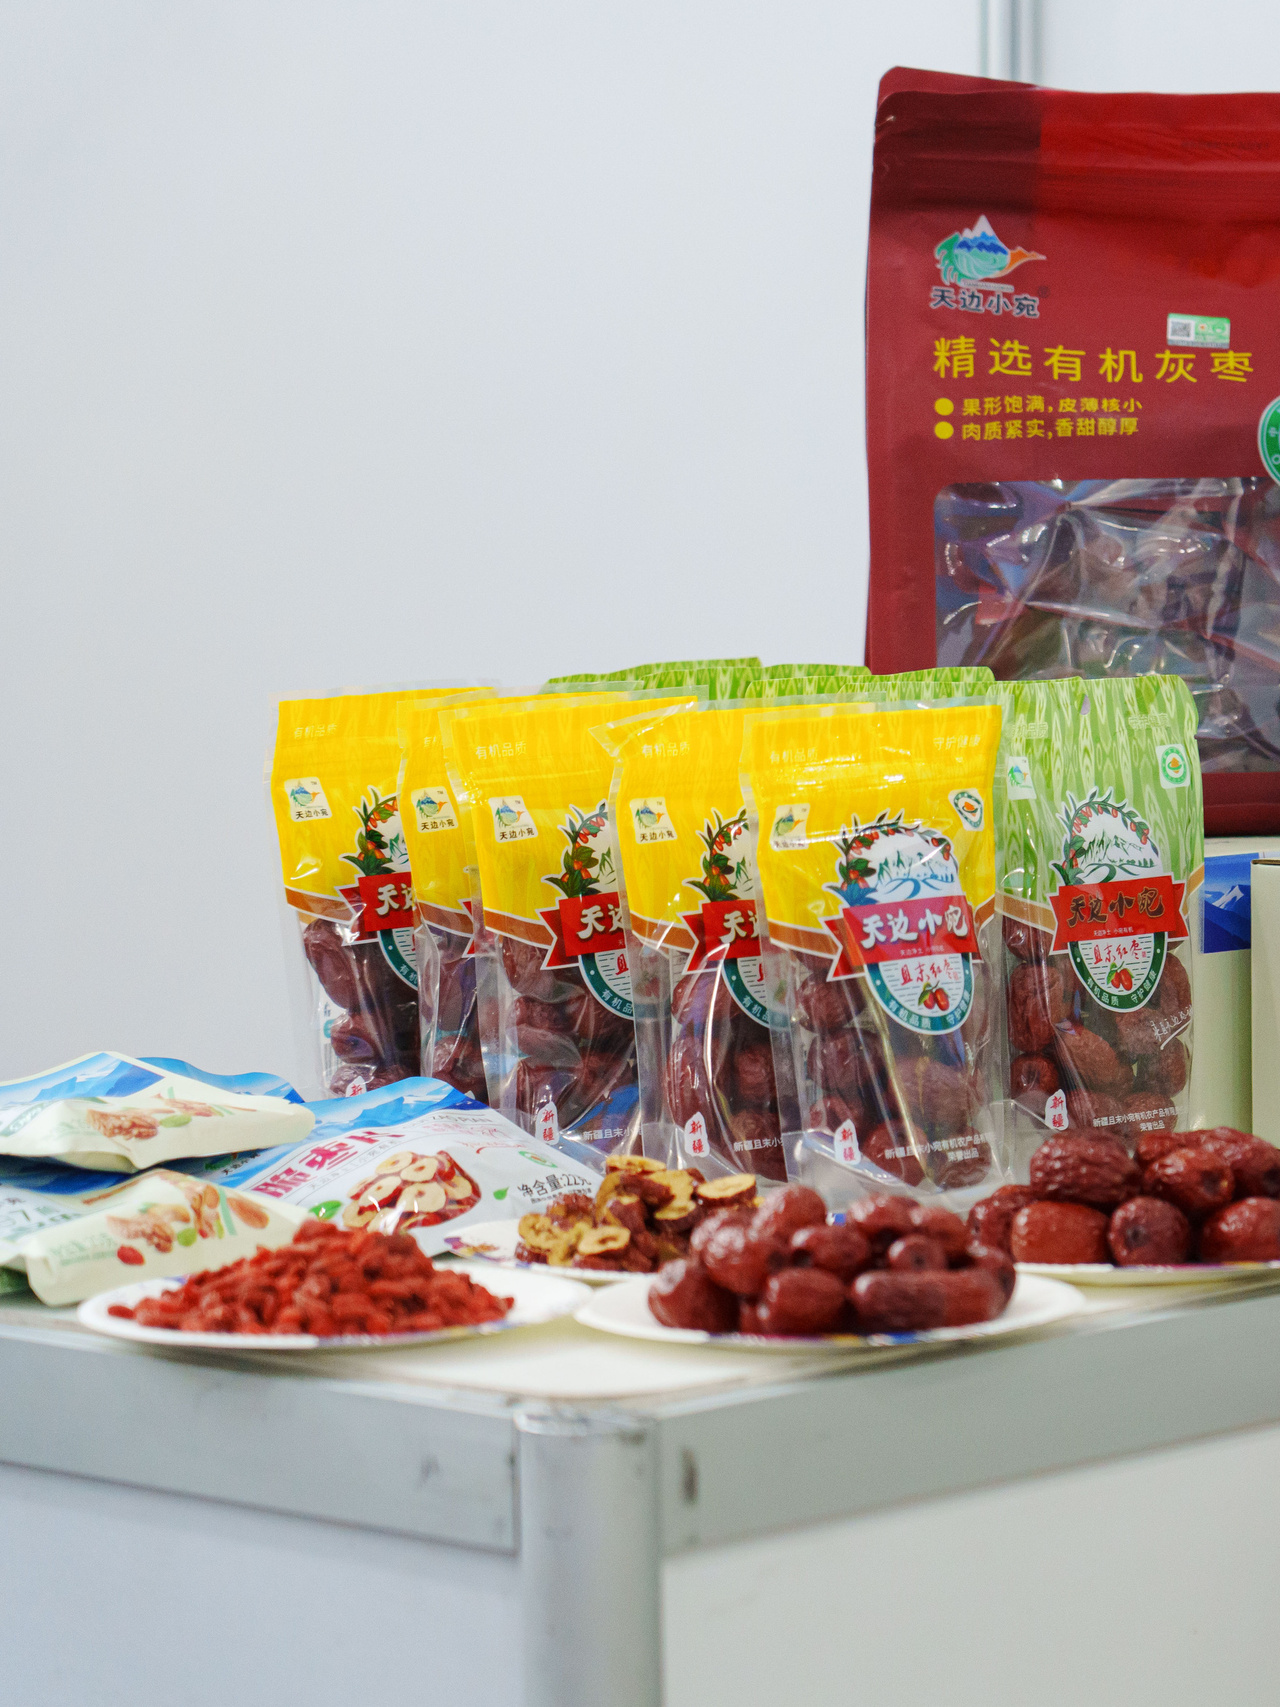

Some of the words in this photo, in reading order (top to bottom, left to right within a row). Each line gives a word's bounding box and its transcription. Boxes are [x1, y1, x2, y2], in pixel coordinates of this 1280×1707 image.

[930, 287, 1040, 318] 天边小宛
[933, 335, 1254, 384] 精选有机灰枣
[475, 741, 527, 760] 有机品质
[642, 741, 690, 759] 有机品质
[421, 819, 455, 831] 天边小宛
[499, 827, 535, 841] 天边小宛
[640, 830, 675, 842] 天边小宛
[861, 904, 969, 949] 天边小宛
[543, 1108, 555, 1141] 新疆
[1050, 1096, 1065, 1128] 新疆
[688, 1117, 705, 1154] 新疆
